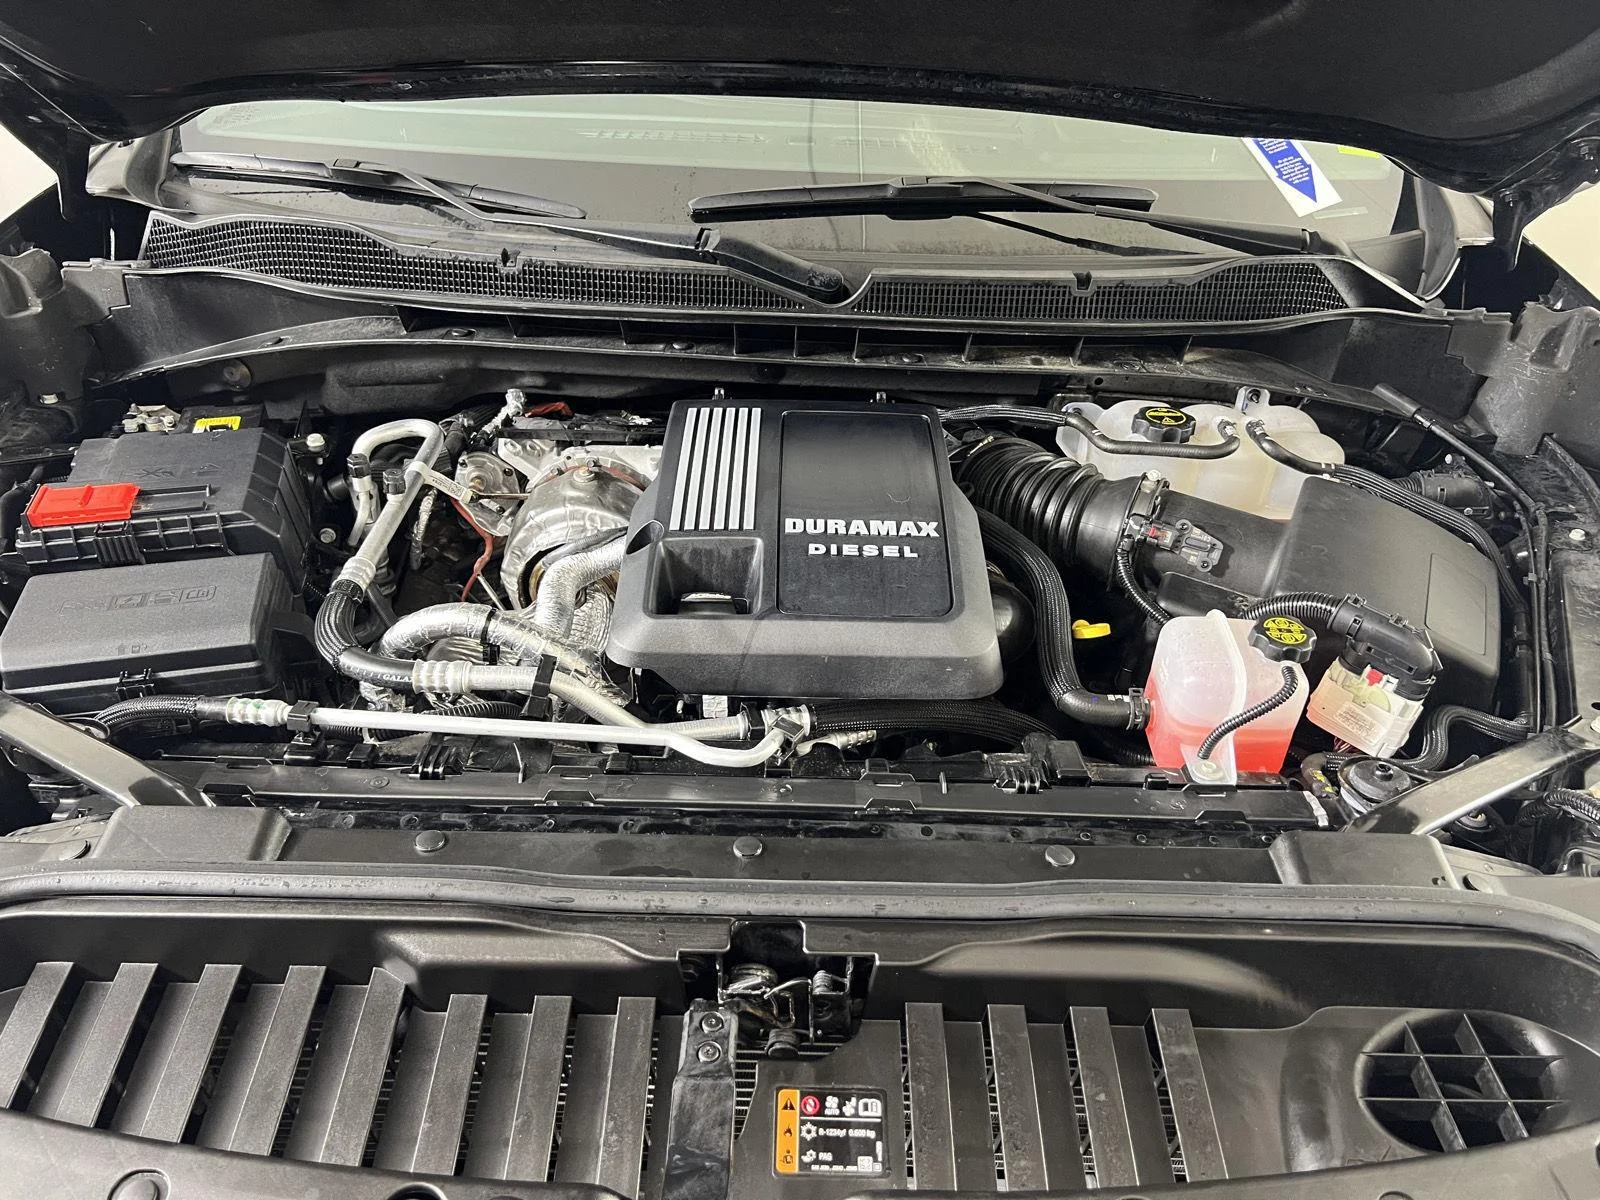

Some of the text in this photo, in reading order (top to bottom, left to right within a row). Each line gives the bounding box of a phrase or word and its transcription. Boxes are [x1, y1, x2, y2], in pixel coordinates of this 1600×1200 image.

[784, 518, 940, 538] DURAMAX
[808, 543, 919, 558] DIESEL
[383, 674, 413, 682] GALA
[818, 1152, 833, 1161] PAG
